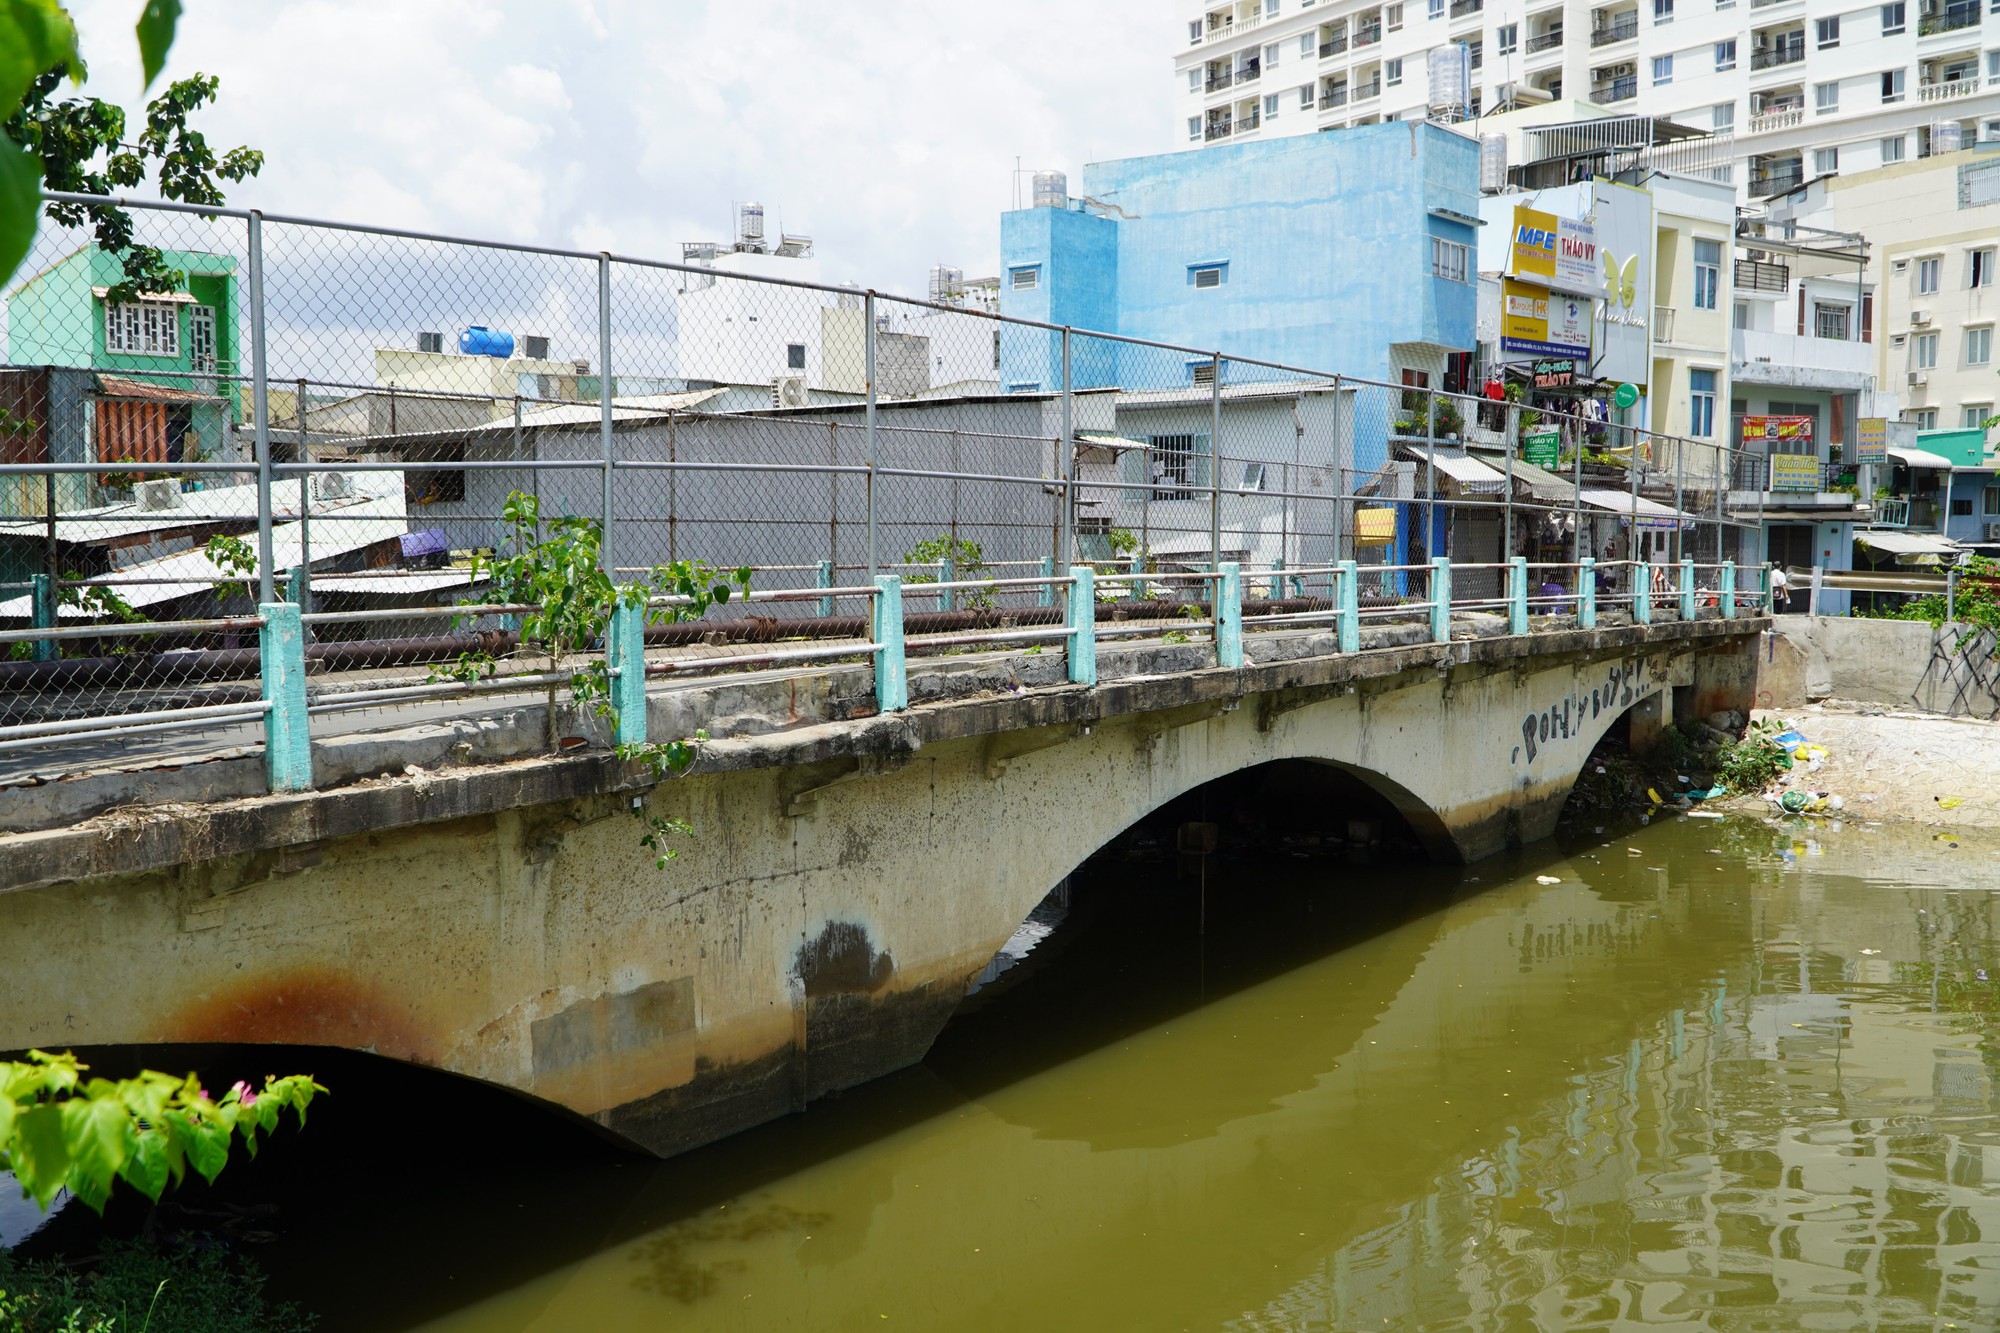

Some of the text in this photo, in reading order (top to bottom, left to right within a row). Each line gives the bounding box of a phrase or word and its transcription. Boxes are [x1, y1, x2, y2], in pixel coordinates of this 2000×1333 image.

[1516, 225, 1556, 250] MPE
[1561, 234, 1583, 258] THẢO
[1585, 243, 1596, 261] VY
[1535, 371, 1572, 387] THẢO VY
[1777, 456, 1799, 471] Quán
